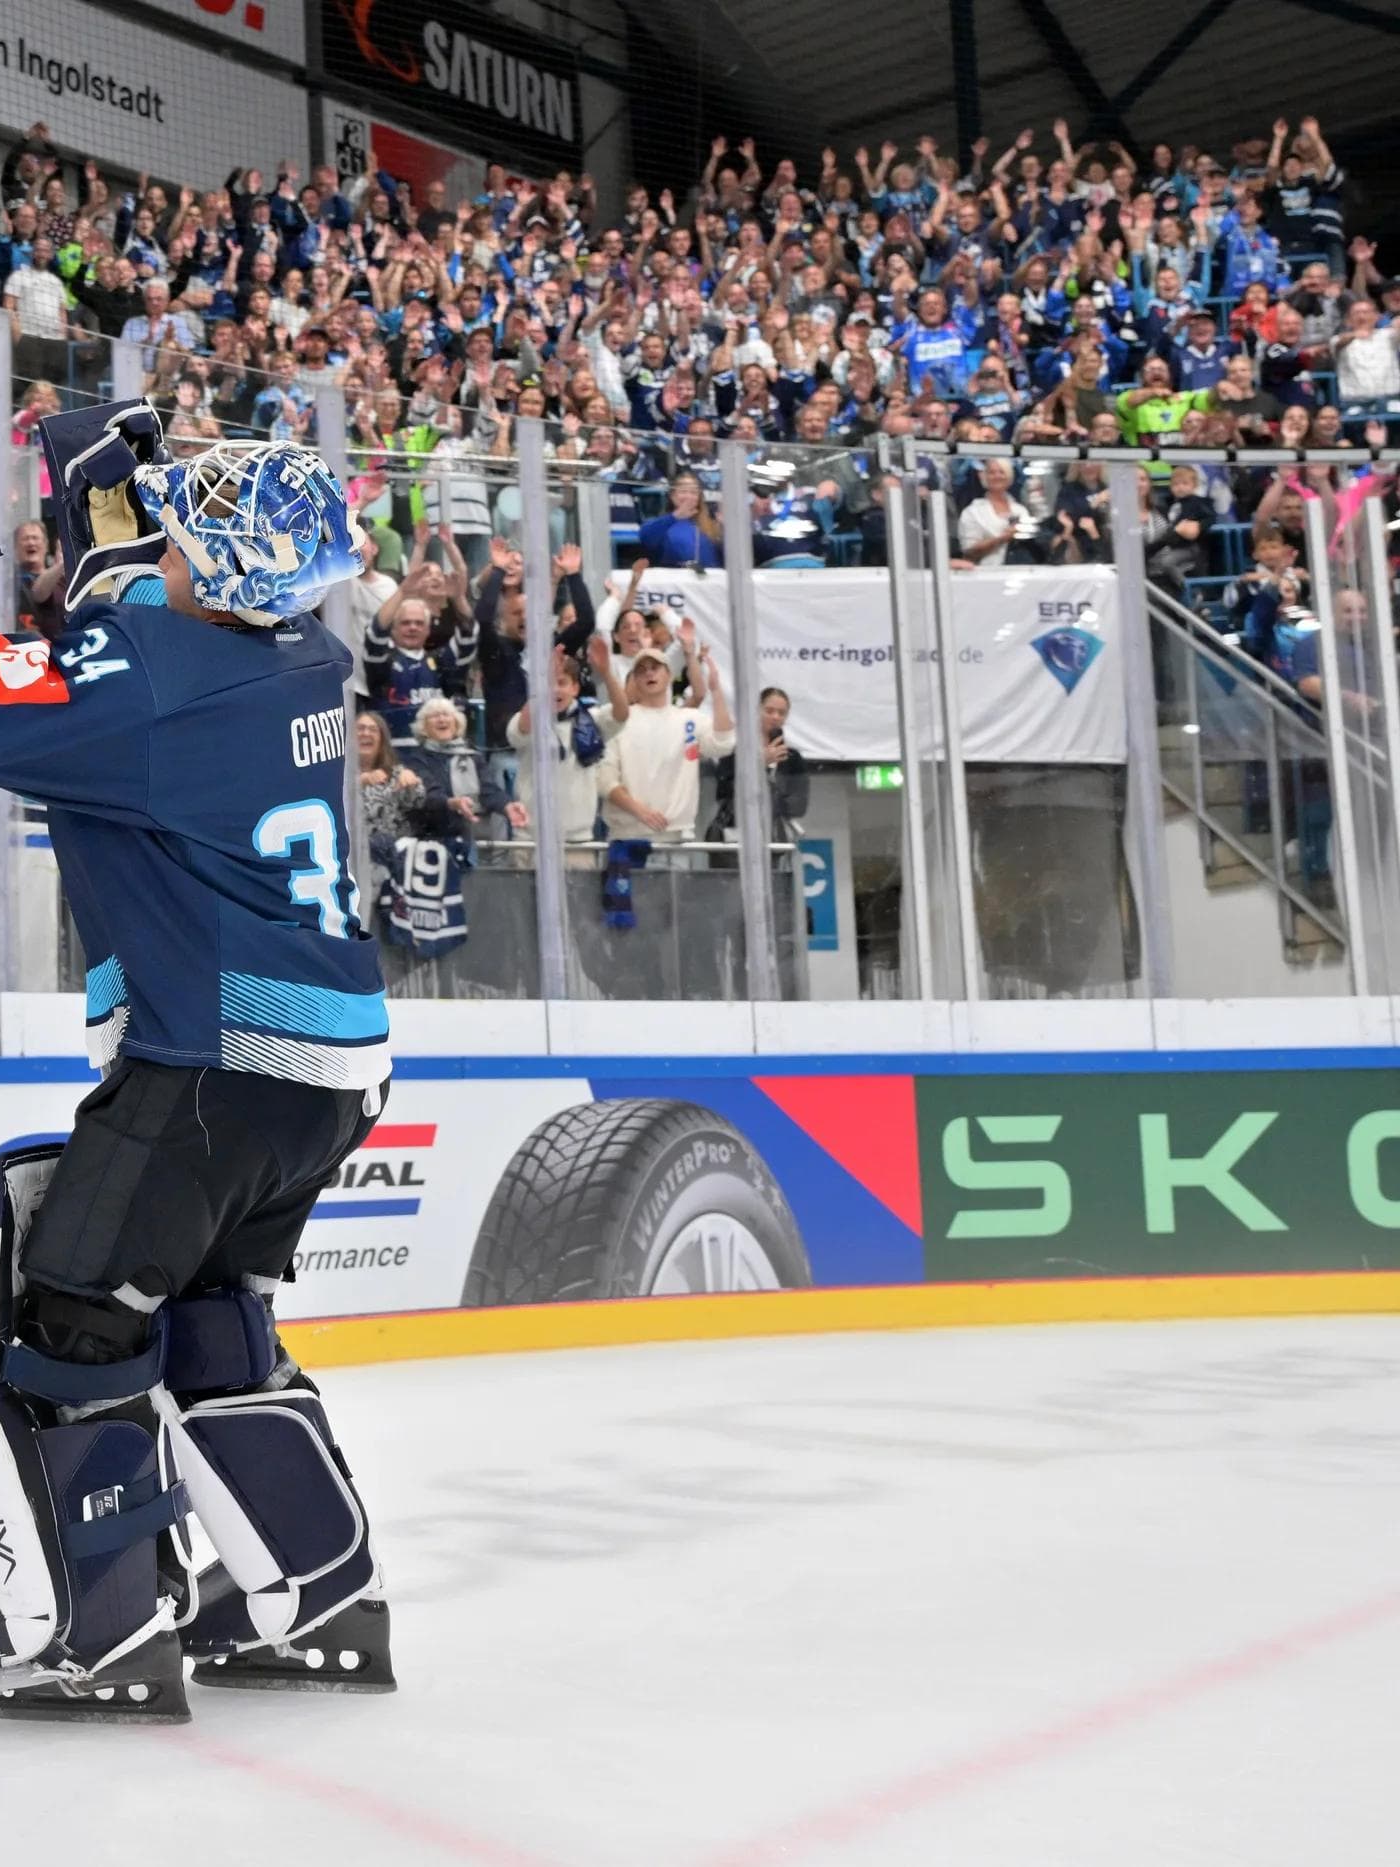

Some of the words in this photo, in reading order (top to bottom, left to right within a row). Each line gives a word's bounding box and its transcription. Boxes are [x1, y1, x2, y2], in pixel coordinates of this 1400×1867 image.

[19, 38, 165, 123] Ingolstadt
[423, 20, 575, 142] SATURN
[60, 627, 132, 685] 34
[394, 836, 448, 897] 19
[292, 1245, 410, 1273] ormance
